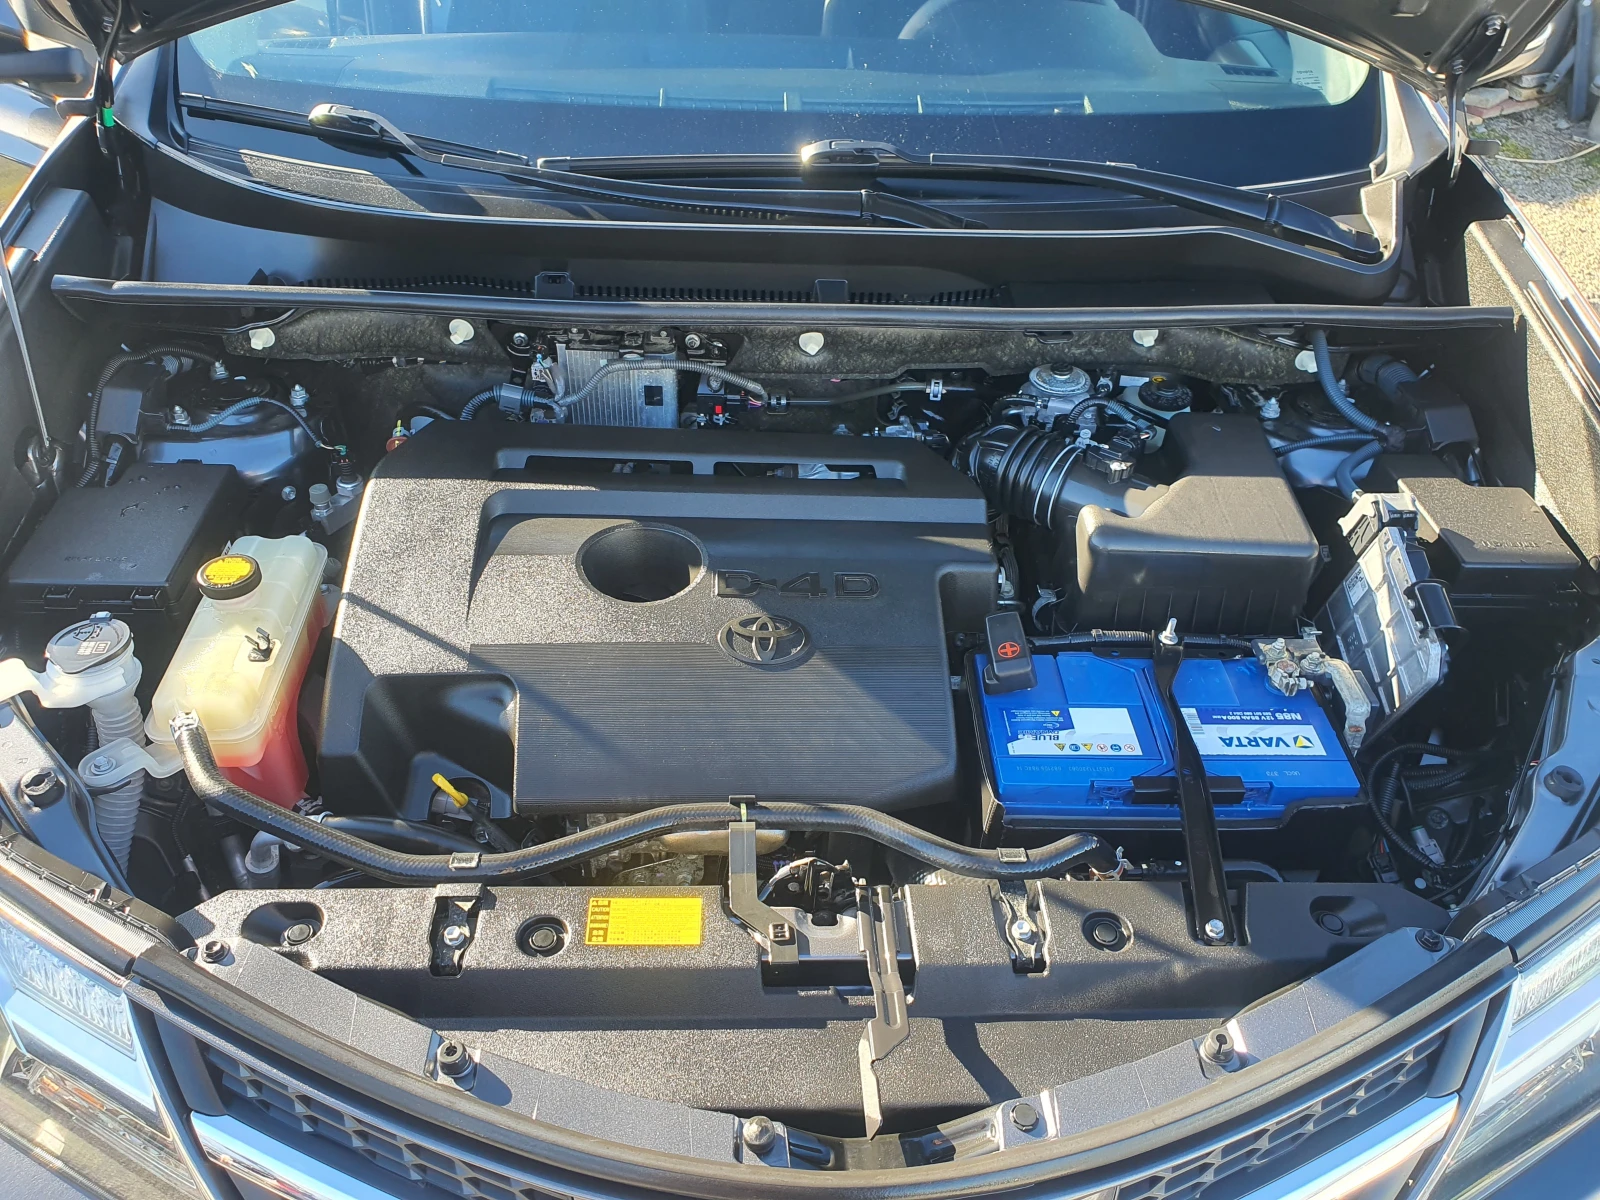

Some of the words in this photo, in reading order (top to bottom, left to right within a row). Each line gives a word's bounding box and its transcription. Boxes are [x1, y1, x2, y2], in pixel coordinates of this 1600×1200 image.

[715, 569, 880, 599] D-4D
[1275, 712, 1303, 721] N85
[1218, 736, 1291, 748] VARTA
